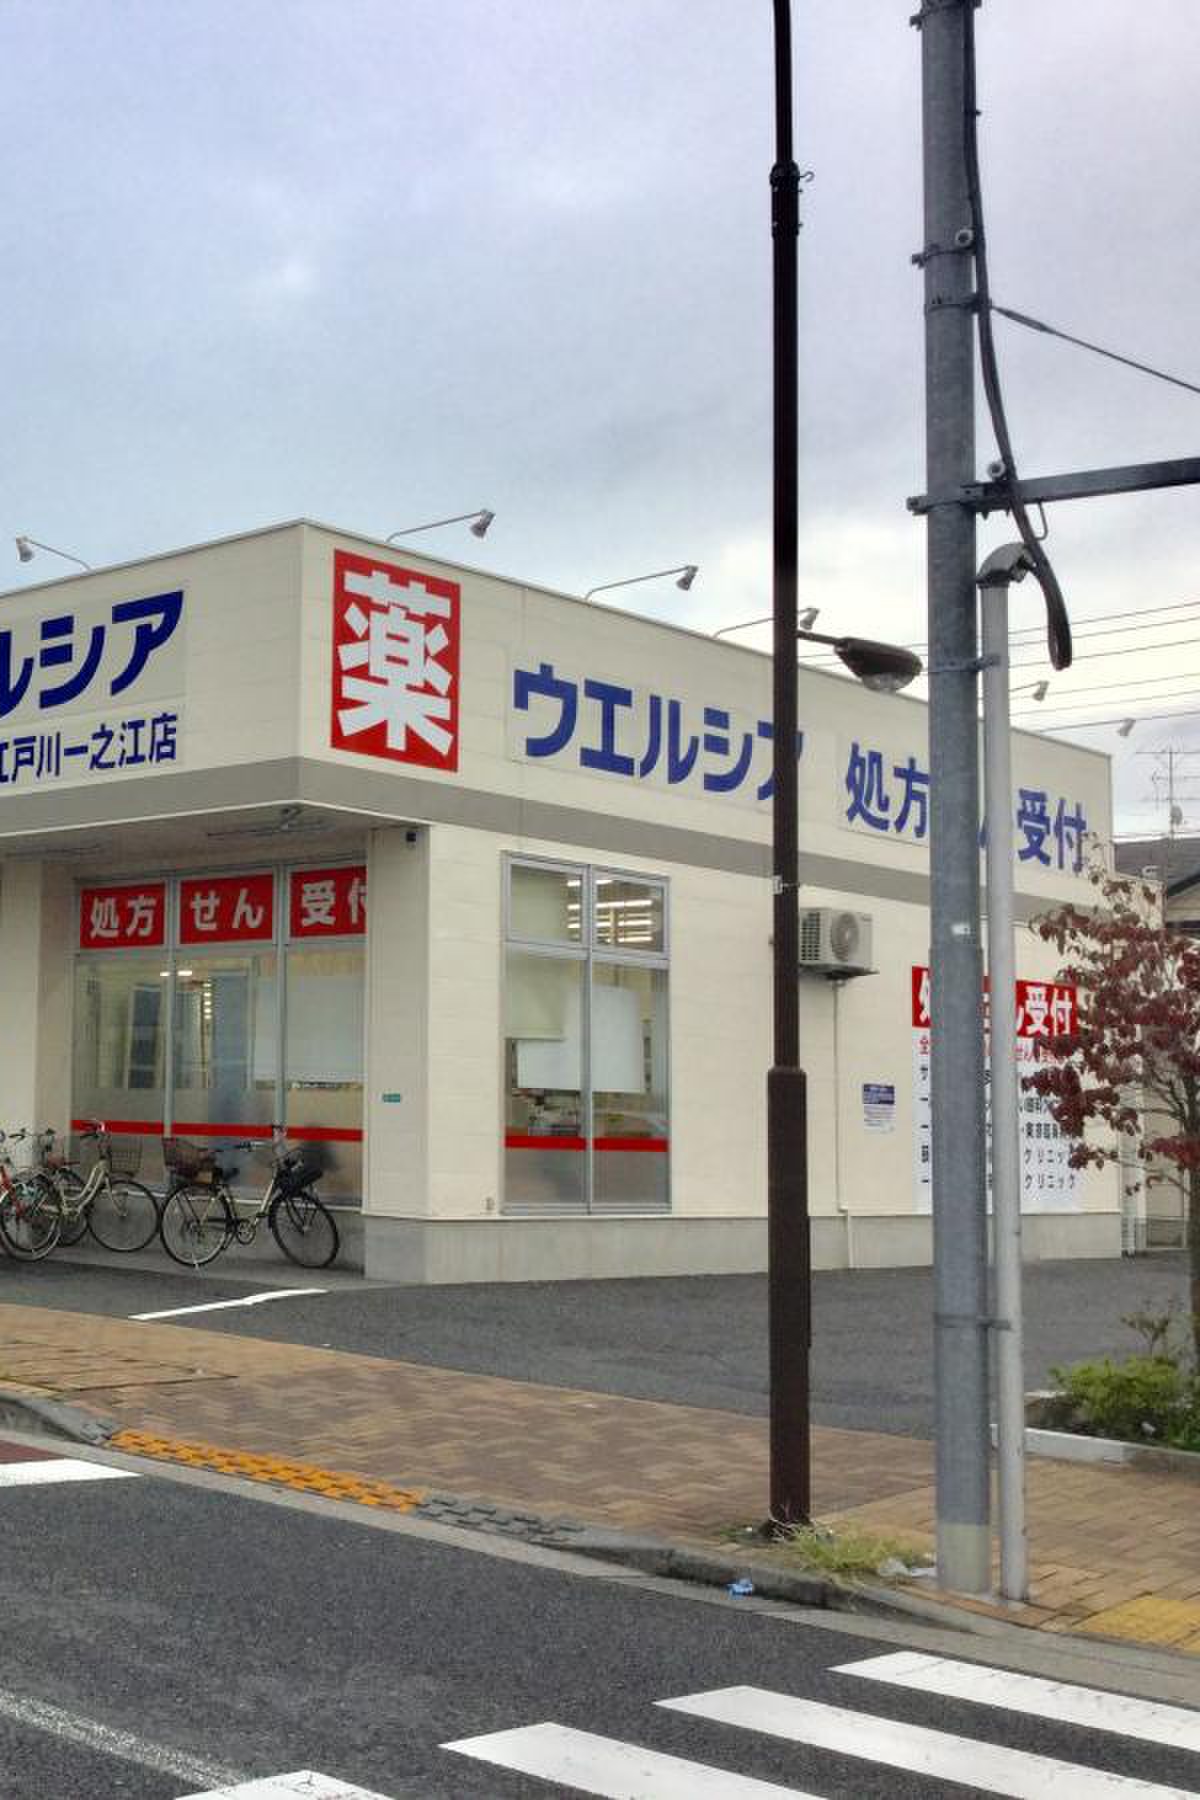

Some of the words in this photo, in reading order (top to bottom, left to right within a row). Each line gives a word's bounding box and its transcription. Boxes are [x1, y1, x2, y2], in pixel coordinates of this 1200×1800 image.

[337, 568, 454, 756] 薬
[89, 895, 156, 939] 処方
[190, 887, 265, 932] せん
